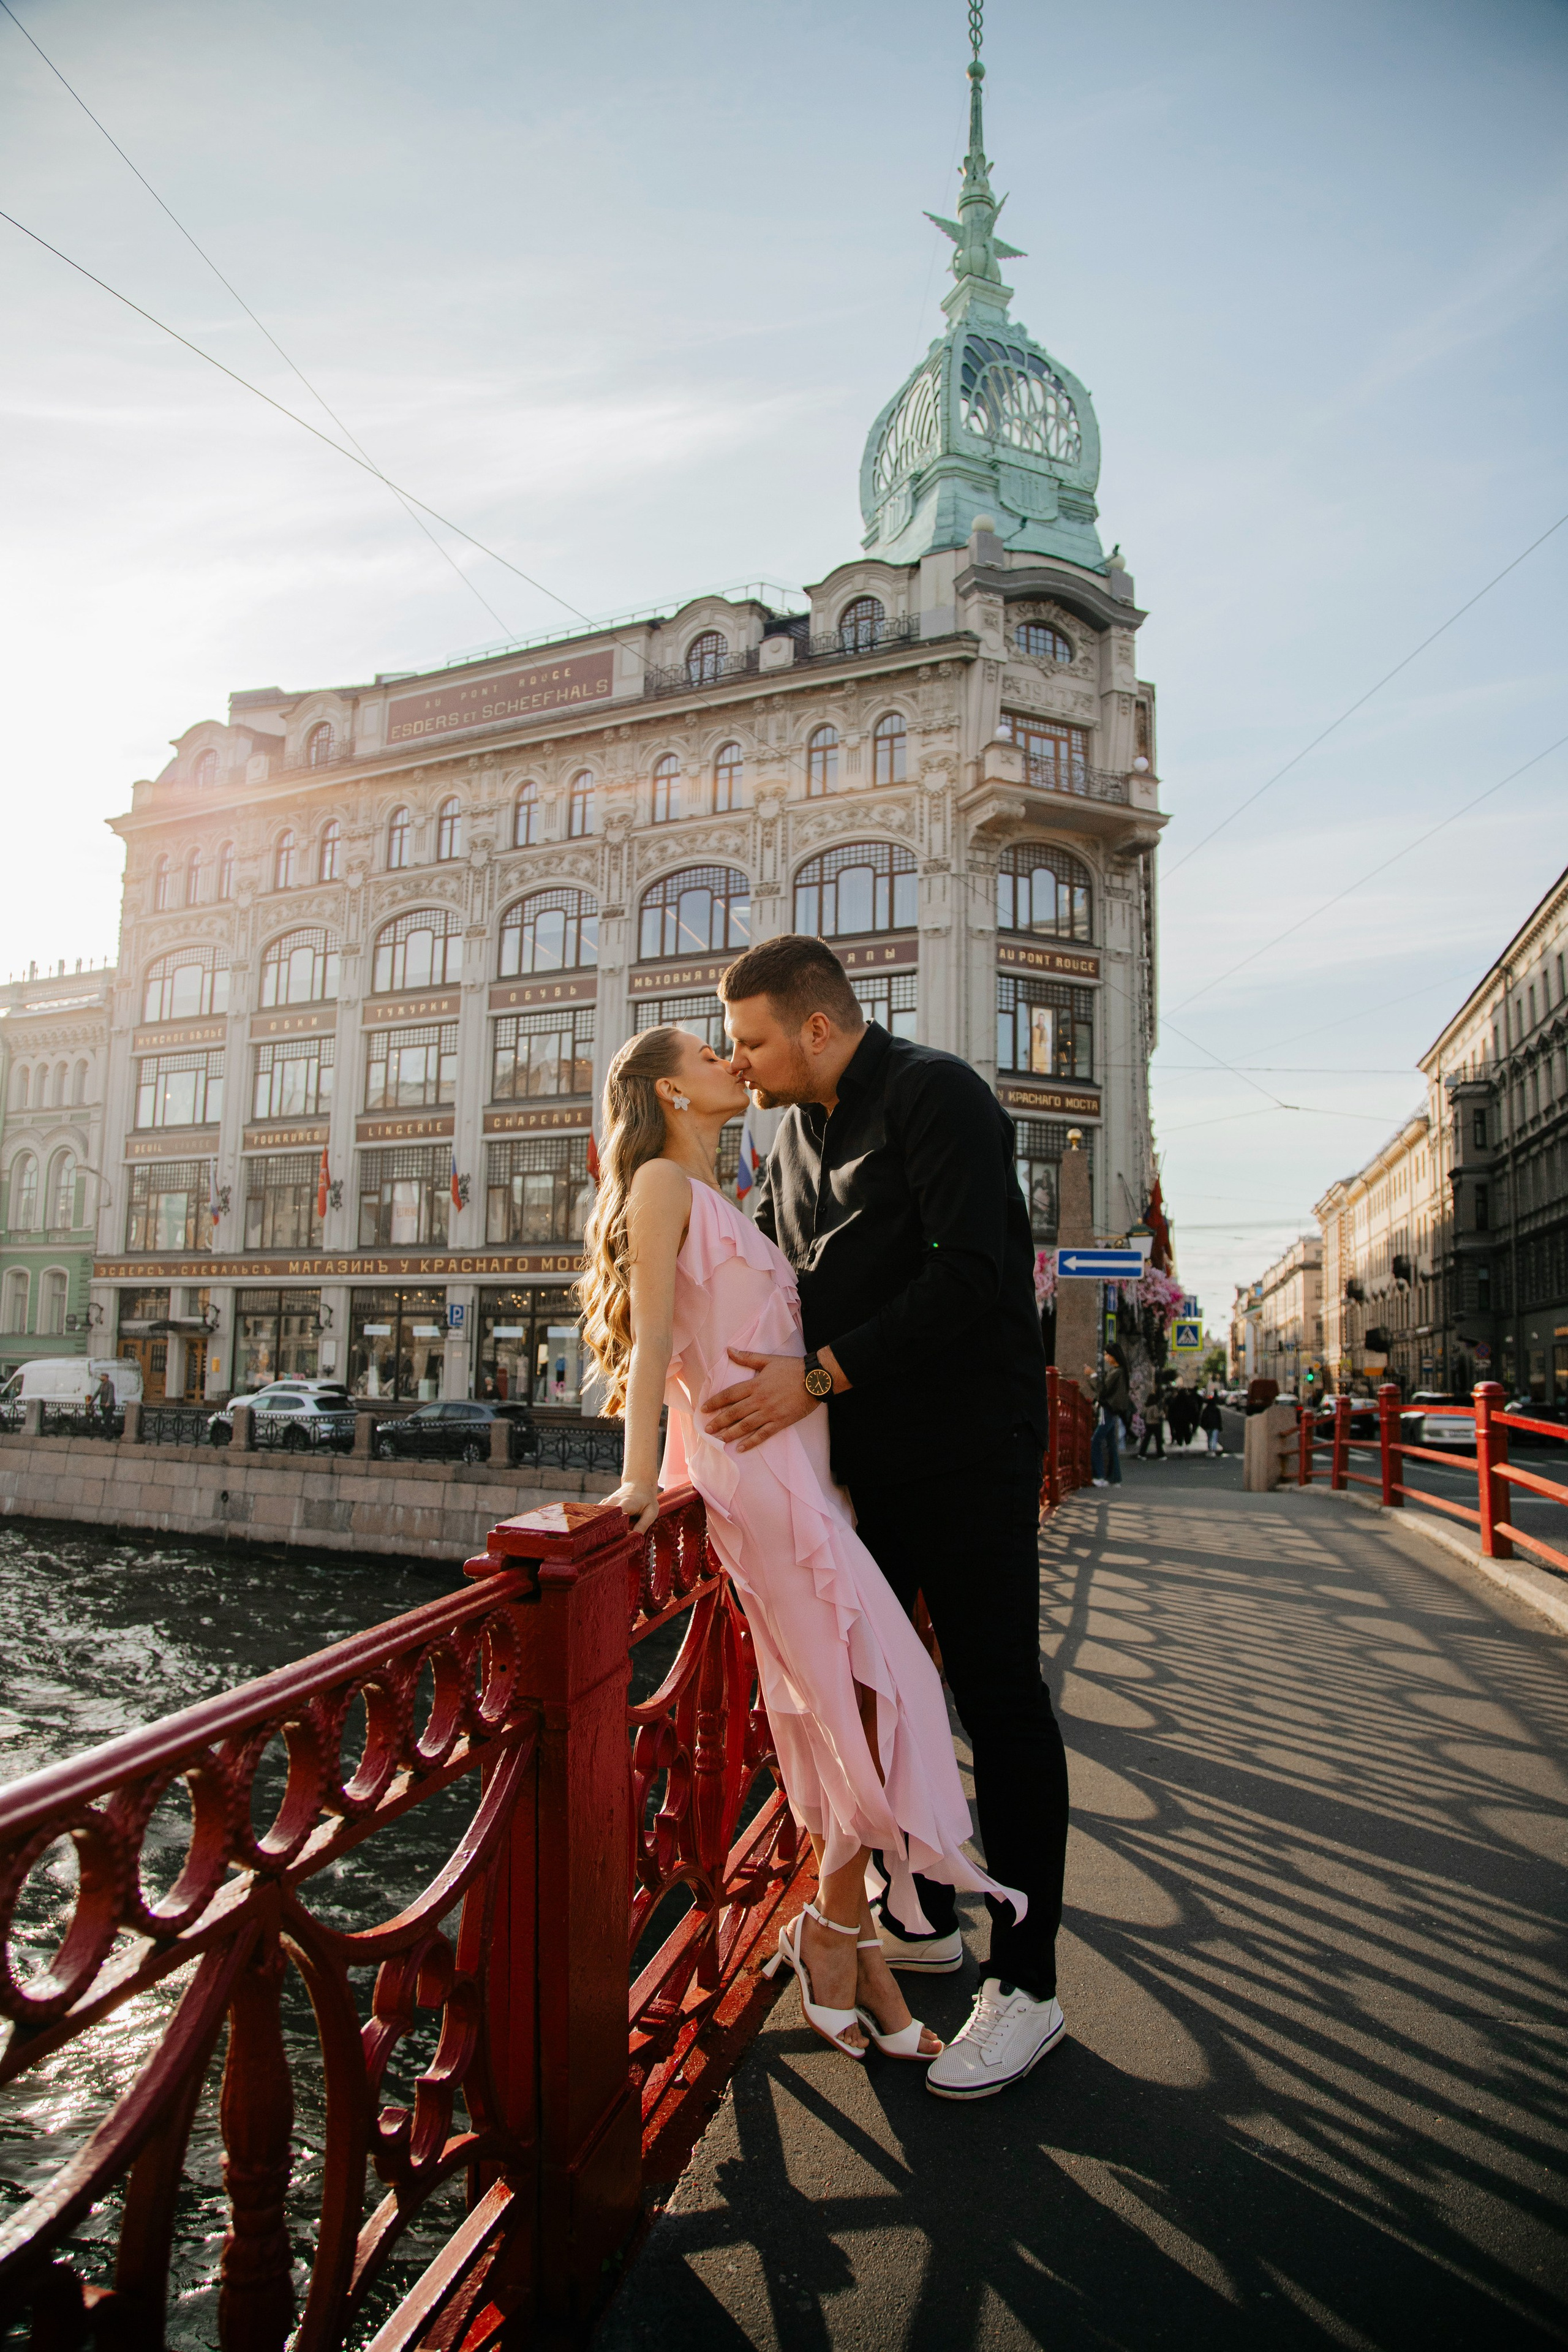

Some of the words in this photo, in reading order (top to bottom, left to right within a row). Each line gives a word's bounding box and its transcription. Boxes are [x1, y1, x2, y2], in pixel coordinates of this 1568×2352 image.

[425, 698, 441, 709] AU
[461, 685, 498, 700] PONT
[519, 668, 571, 687] ROUGE
[391, 712, 459, 739] ESDERS
[463, 711, 477, 723] ET
[481, 679, 608, 718] SCHEEFHALS
[846, 948, 895, 963] ЯПЫ
[998, 948, 1015, 960] AU
[1018, 951, 1050, 966] PONT
[1055, 956, 1096, 974] ROUGE
[709, 967, 725, 979] ВЕ
[509, 985, 577, 1002] ОБУВЬ
[376, 1000, 448, 1018] ТУЖУРКИ
[997, 1089, 1004, 1101] У
[1008, 1091, 1061, 1107] КРАСНАГО
[1065, 1096, 1099, 1111] МОСТА
[494, 1112, 583, 1128] CHAPEAUX
[254, 1131, 320, 1145] FOURRURES
[368, 1122, 443, 1137] LINGERIE
[134, 1142, 162, 1155] DEUIL
[99, 1265, 165, 1276] ЭСДЕРСЪ
[181, 1264, 272, 1276] СХЕФАЛЬСЪ
[288, 1259, 388, 1274] МАГАЗИНЪ
[401, 1260, 409, 1272] У
[420, 1257, 529, 1273] КРАСНАГО
[541, 1256, 584, 1272] МОС
